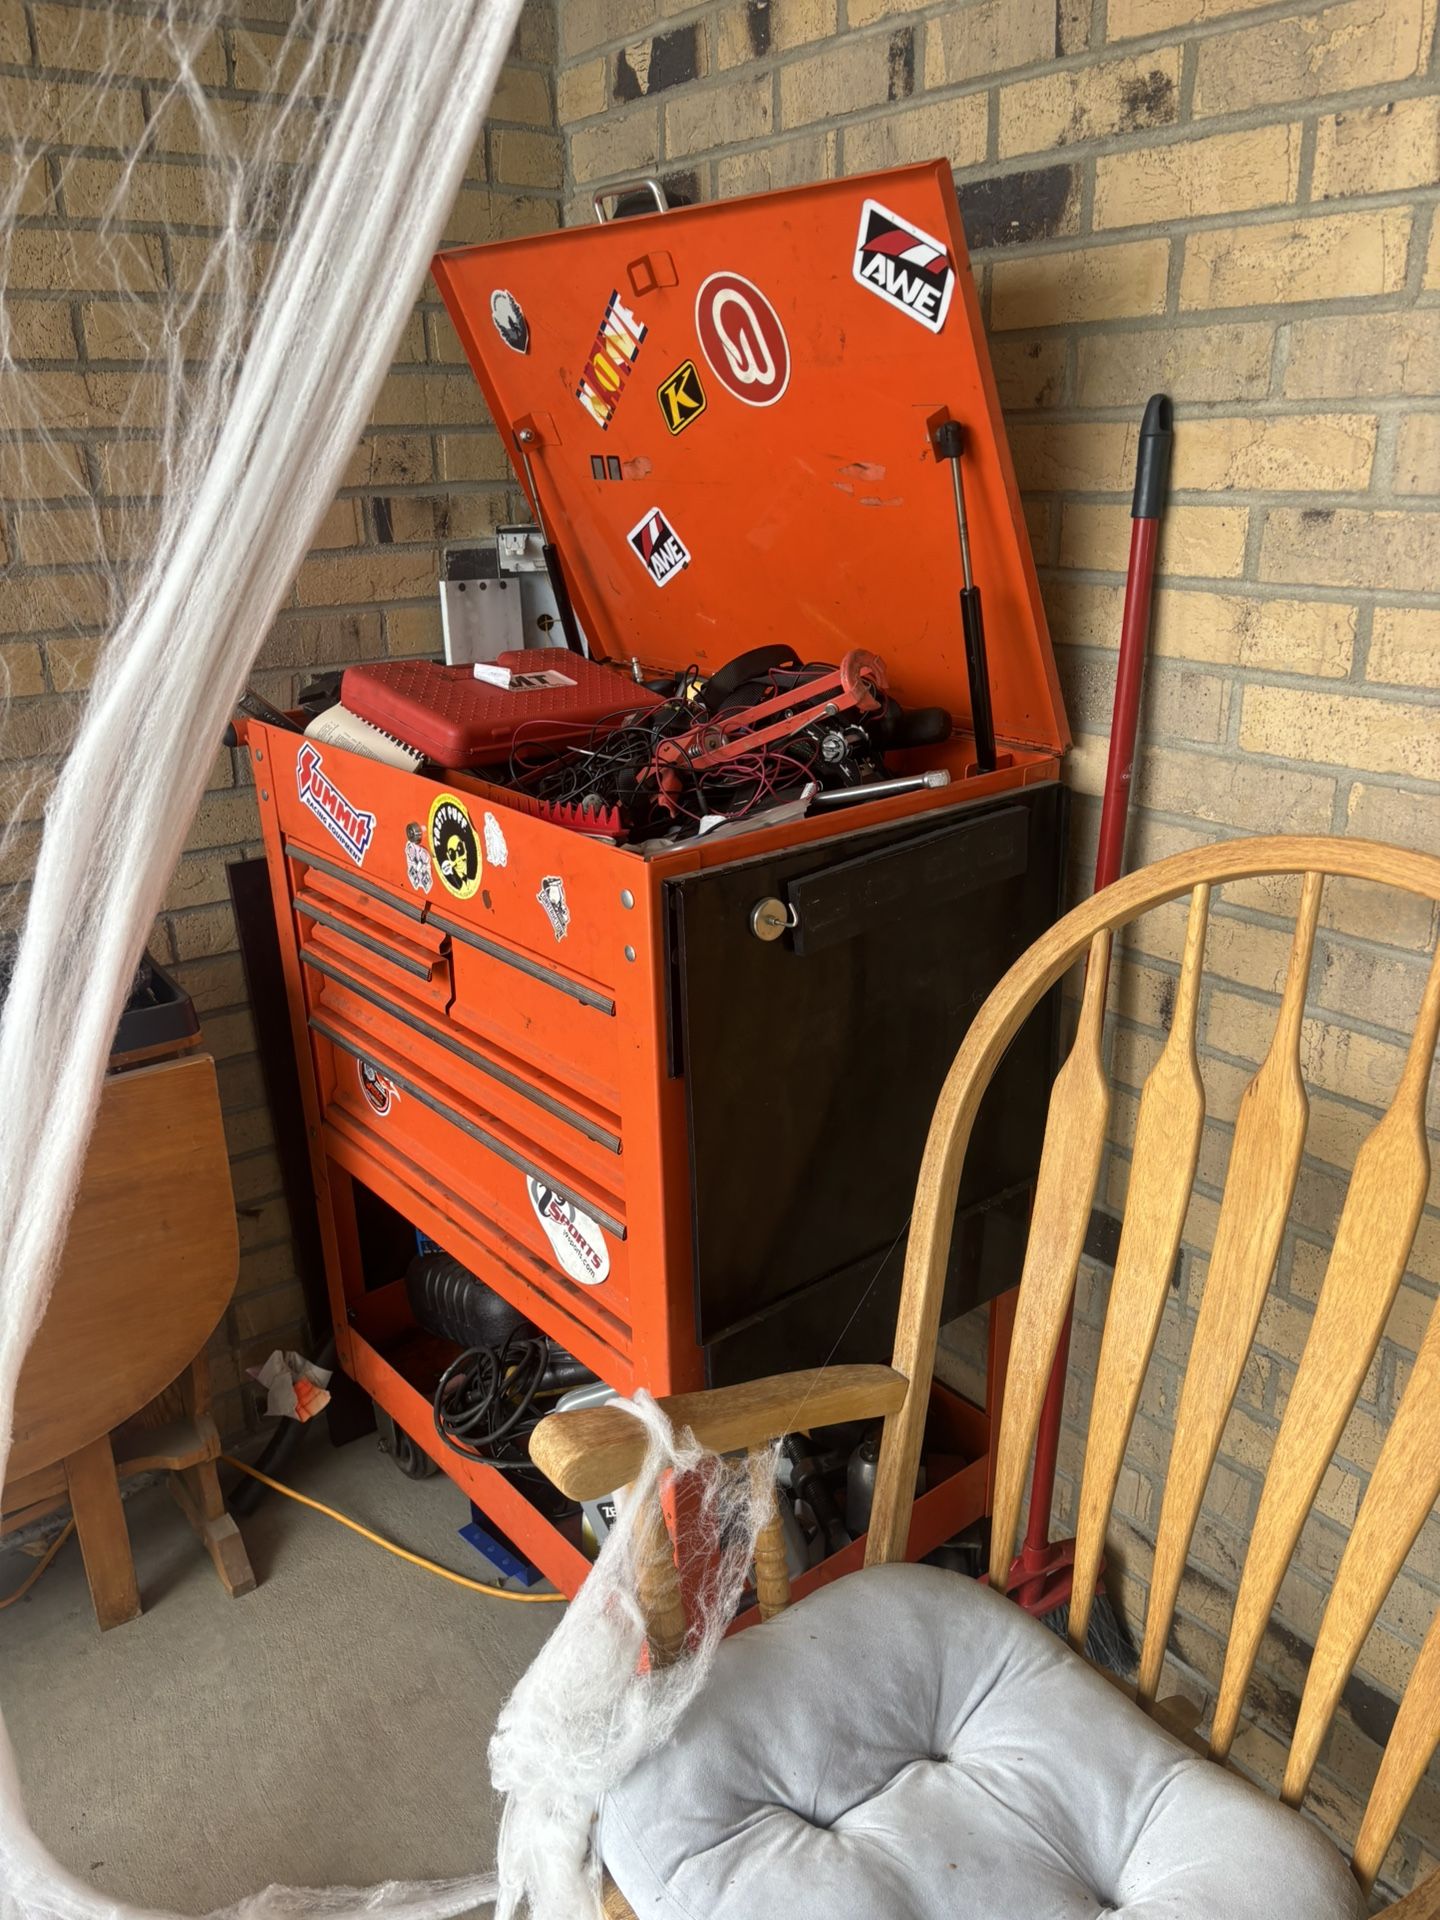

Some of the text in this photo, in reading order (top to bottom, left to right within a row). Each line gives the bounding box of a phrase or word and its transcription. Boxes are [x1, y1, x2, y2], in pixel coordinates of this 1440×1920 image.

[861, 252, 943, 319] AWE
[650, 535, 684, 580] AWE
[305, 797, 363, 863] RACING EQUIPMENT
[548, 1200, 603, 1270] SPORTS
